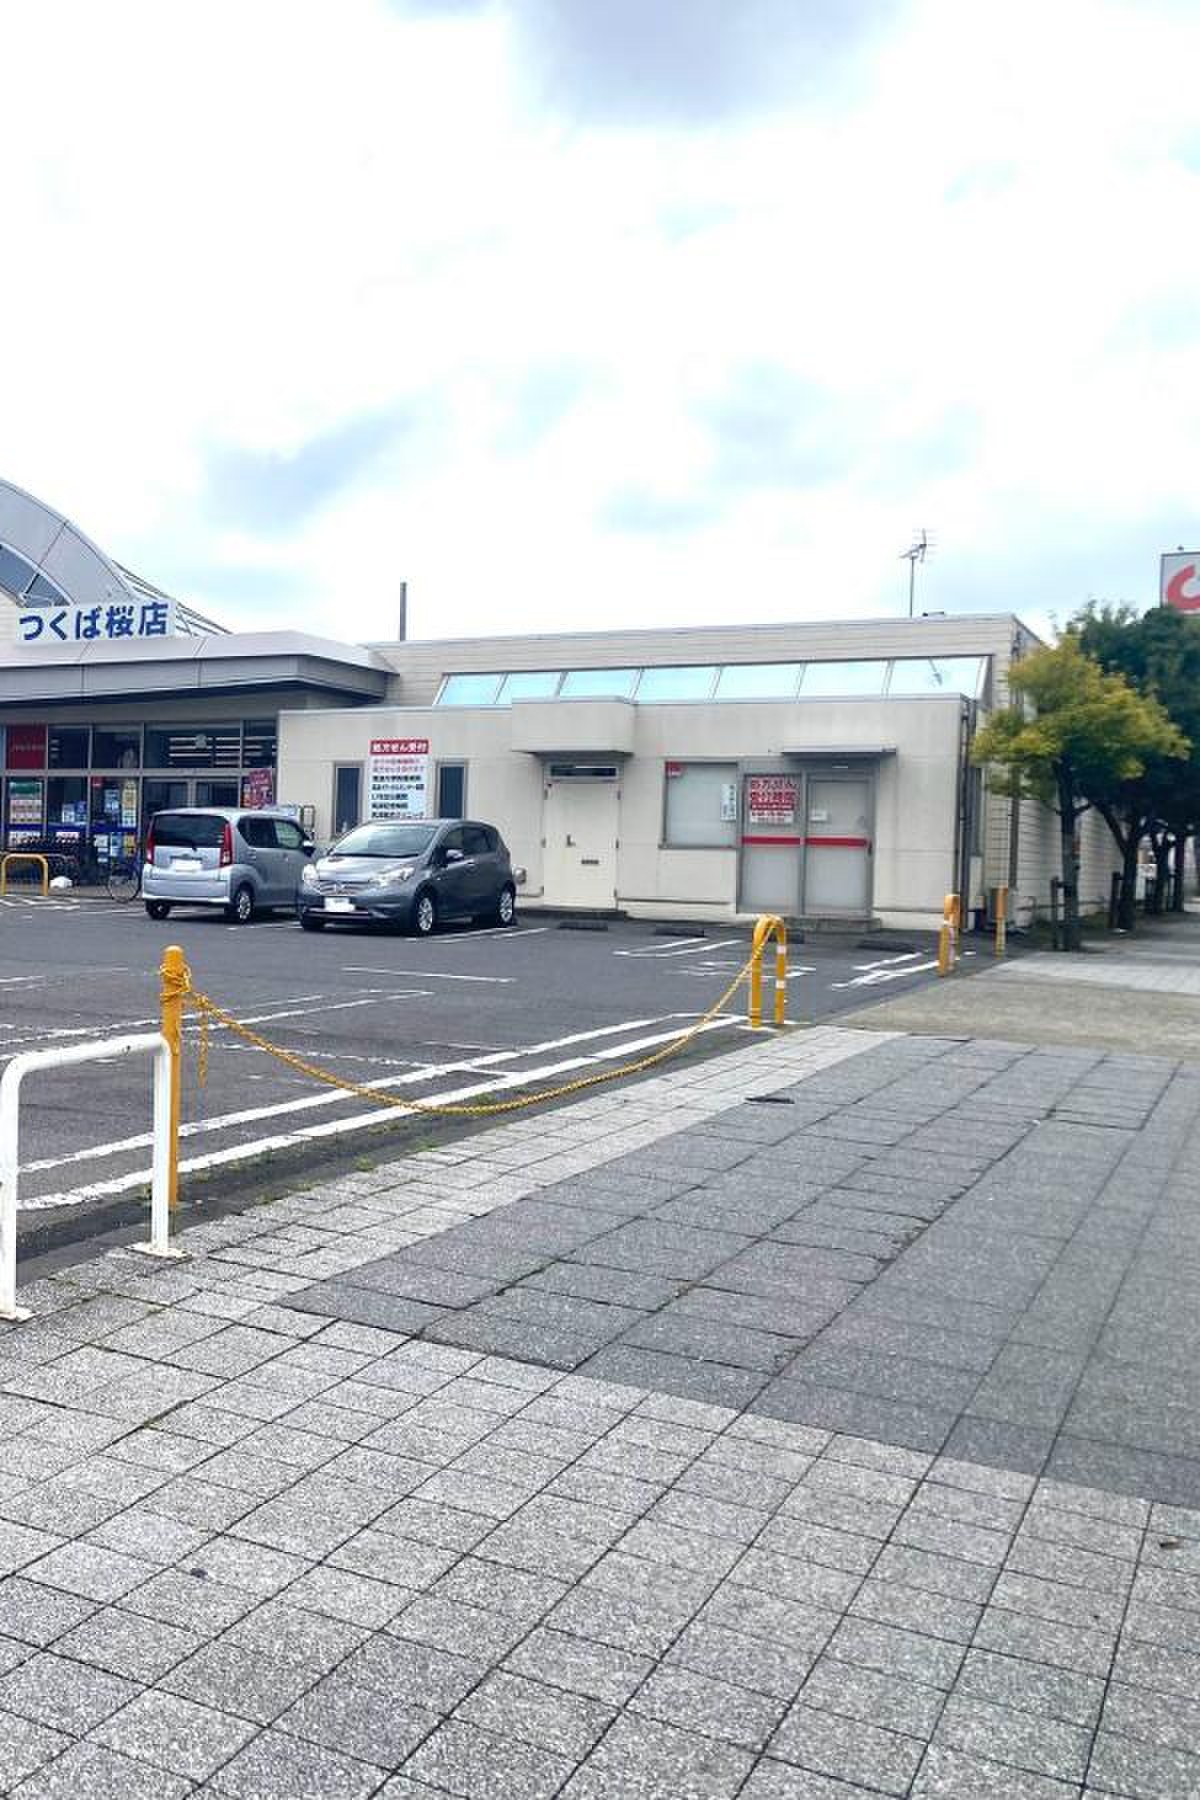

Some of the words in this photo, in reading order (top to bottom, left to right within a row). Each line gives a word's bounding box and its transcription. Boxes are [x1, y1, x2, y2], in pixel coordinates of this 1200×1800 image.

[19, 601, 169, 640] つくば桜店
